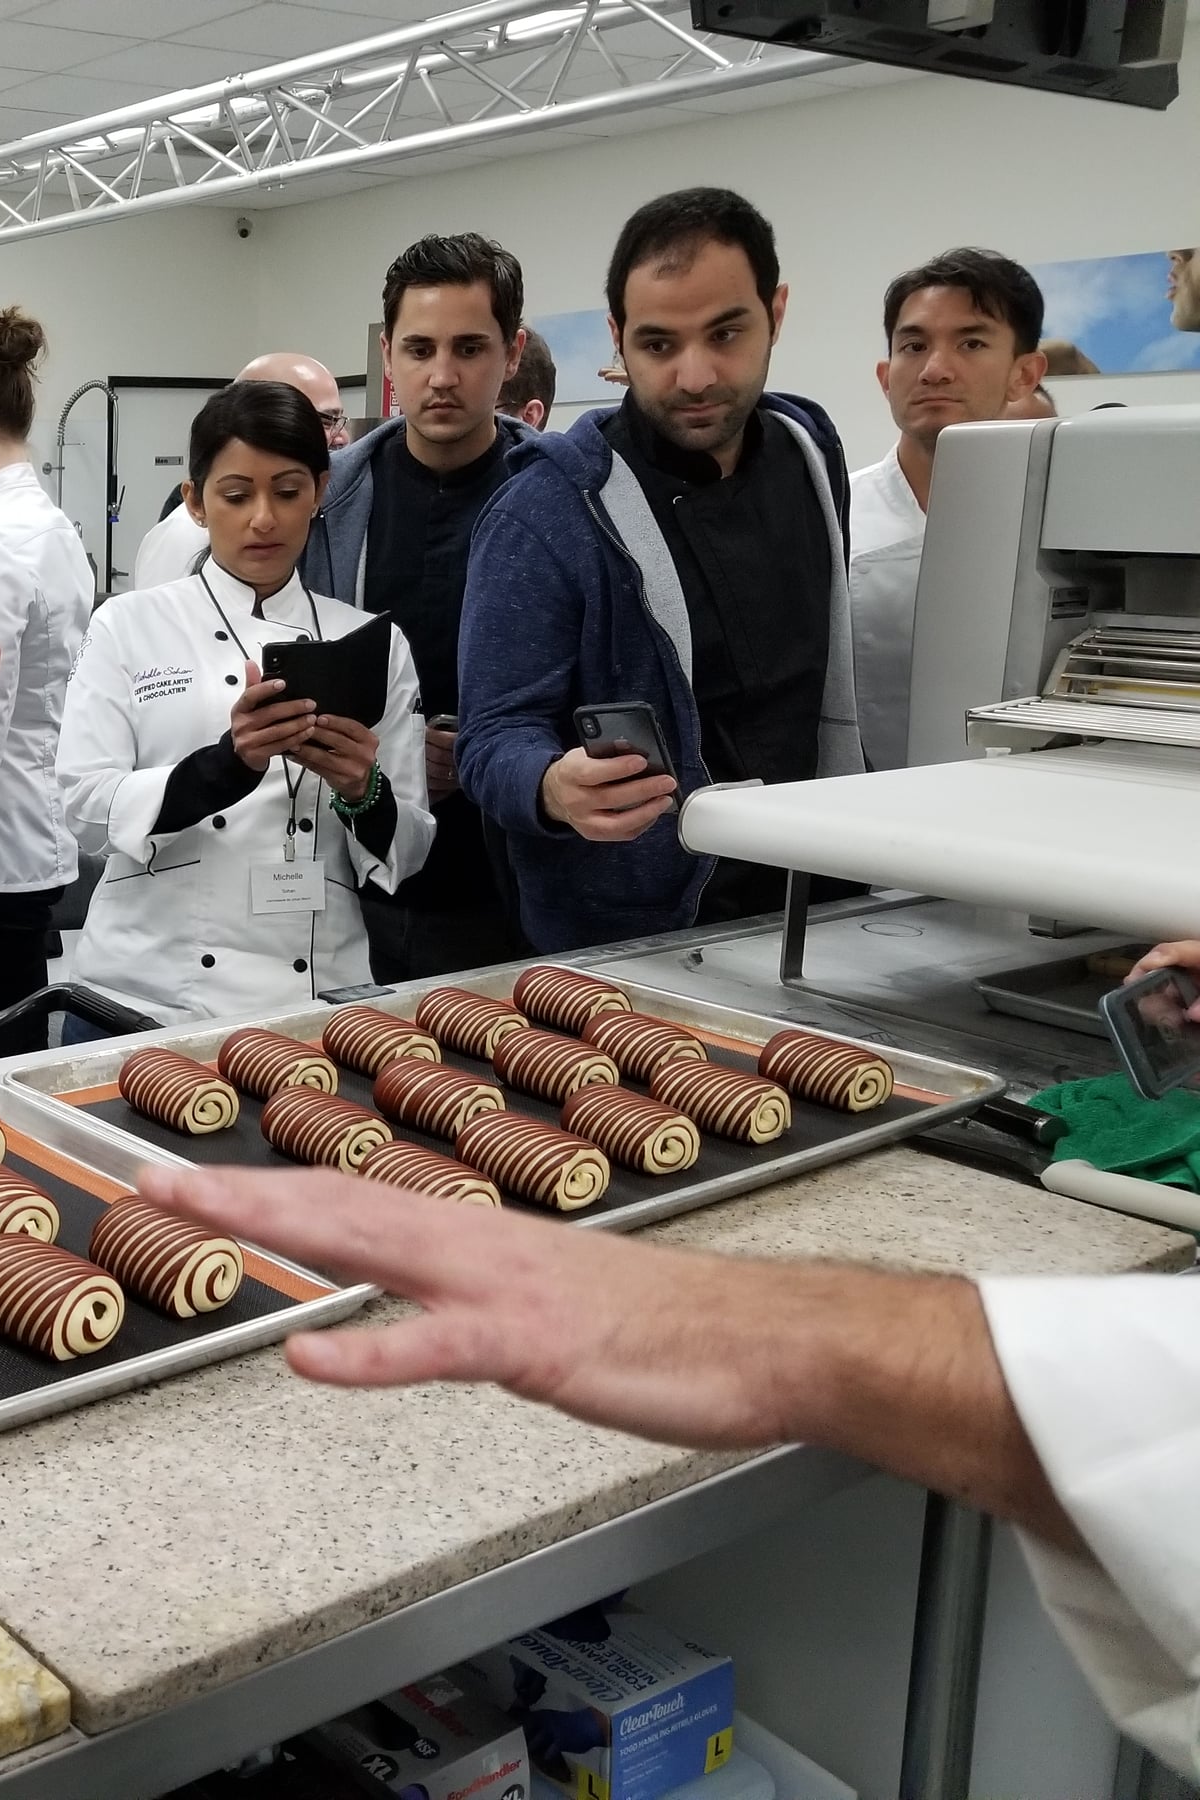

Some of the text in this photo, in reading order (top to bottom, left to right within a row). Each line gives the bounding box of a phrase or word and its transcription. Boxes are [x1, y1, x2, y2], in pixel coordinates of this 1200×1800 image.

[143, 687, 186, 701] CHOCOLATIER
[156, 680, 172, 688] CAKE
[172, 678, 193, 686] ARTIST
[603, 1648, 658, 1686] NITRILE
[608, 1662, 647, 1691] FOOD
[414, 1738, 437, 1757] NSF
[619, 1743, 638, 1758] FOOD
[714, 1736, 724, 1756] L
[363, 1755, 392, 1781] XL
[447, 1759, 522, 1800] FoodHandler
[588, 1774, 601, 1800] L
